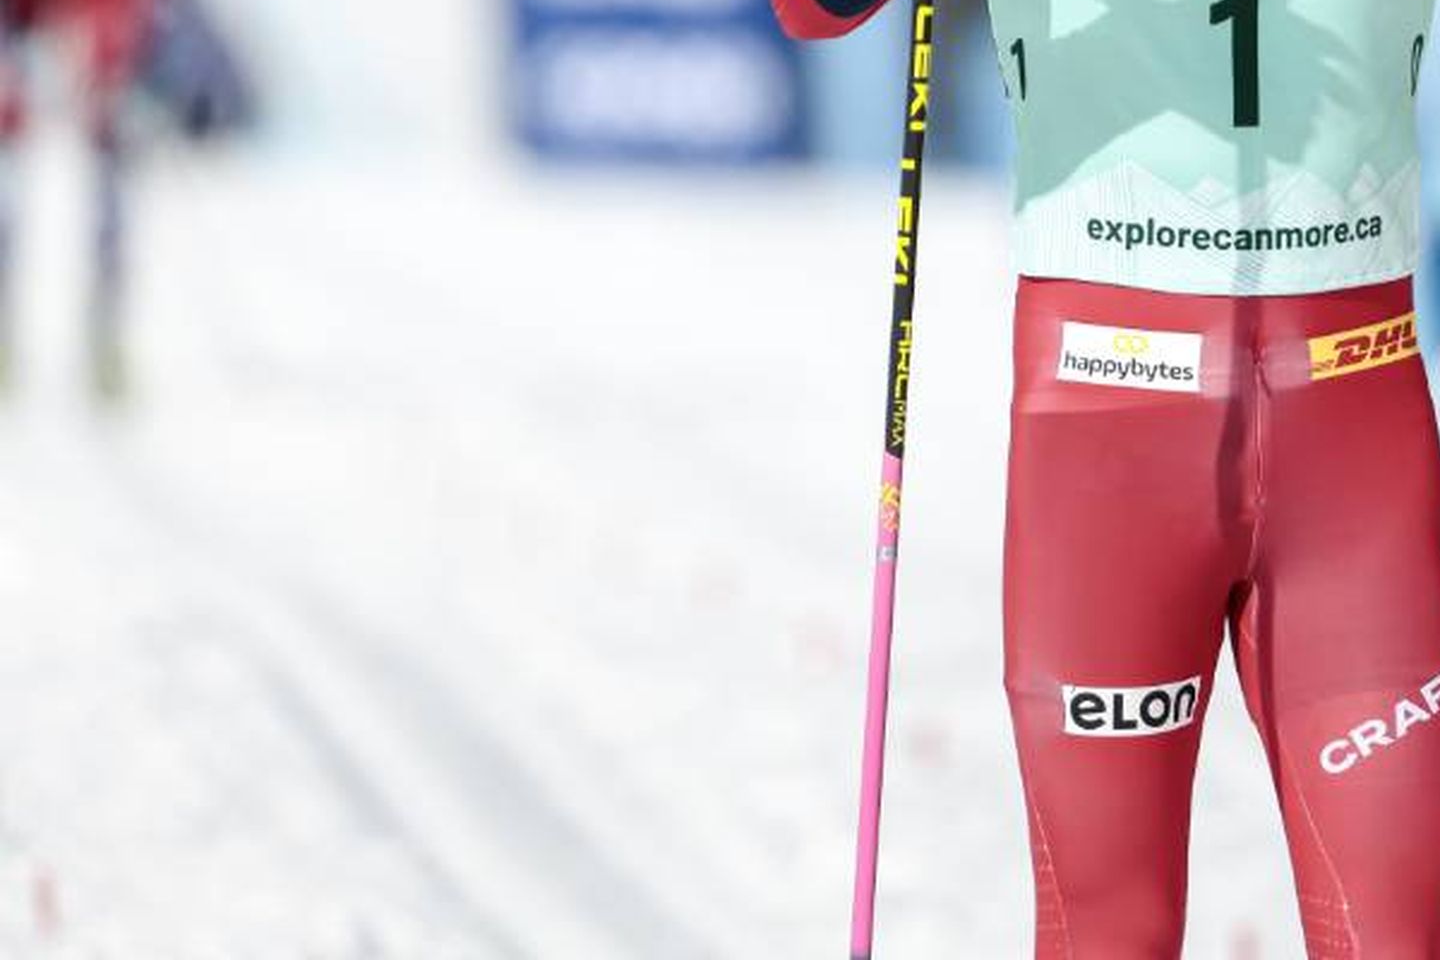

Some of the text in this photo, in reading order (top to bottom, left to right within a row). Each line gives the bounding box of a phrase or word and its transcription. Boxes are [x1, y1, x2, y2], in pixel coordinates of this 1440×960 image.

[909, 5, 935, 132] LEKI
[1010, 38, 1027, 101] 1
[1087, 214, 1382, 252] explorecanmore.ca
[1062, 350, 1194, 382] happybytes
[1335, 320, 1417, 368] DHL
